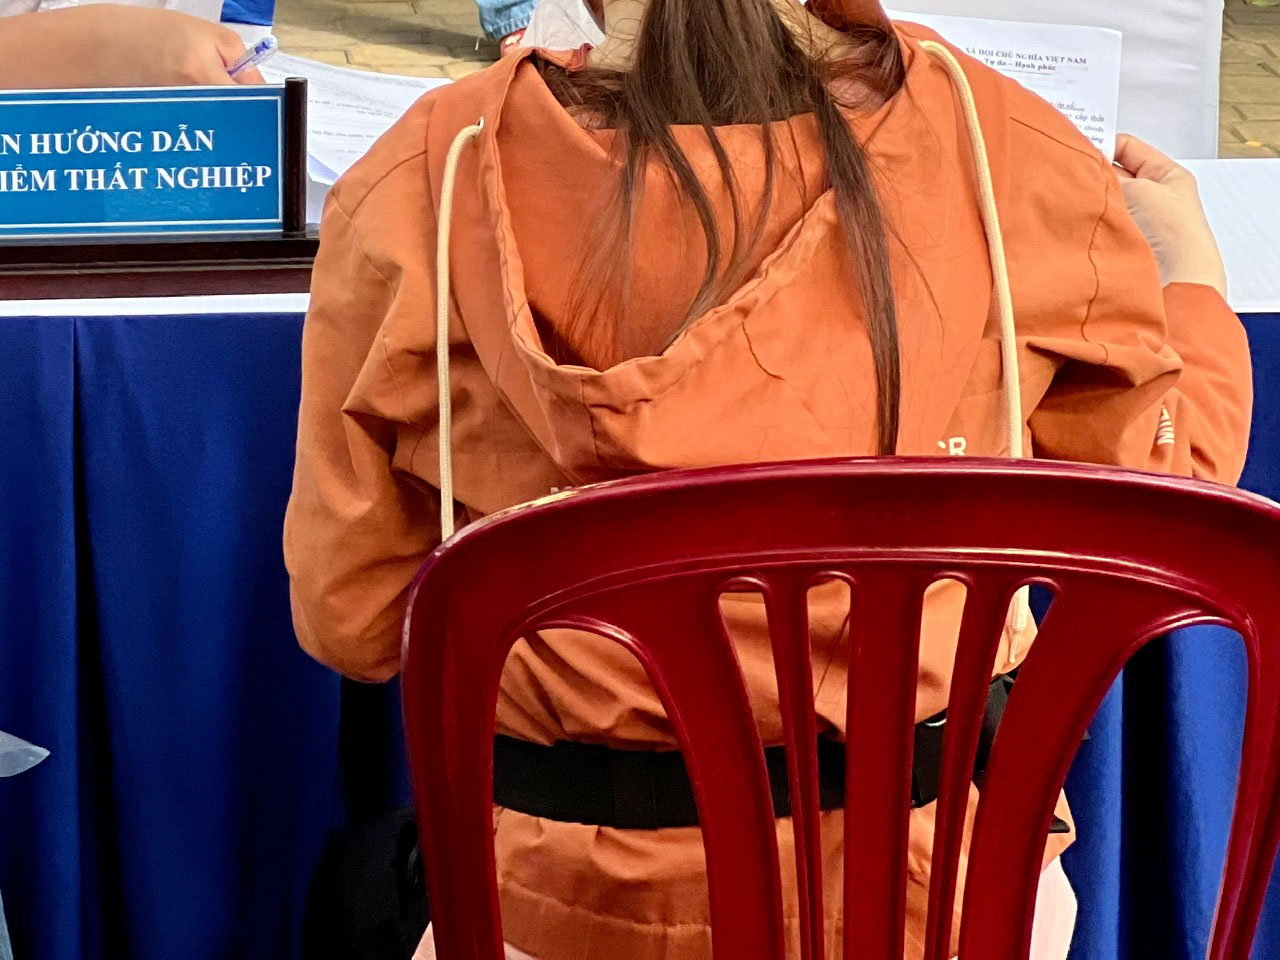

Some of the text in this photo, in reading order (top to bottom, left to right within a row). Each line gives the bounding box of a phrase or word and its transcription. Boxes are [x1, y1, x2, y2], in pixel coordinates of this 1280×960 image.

[29, 125, 143, 155] HƯỚNG
[152, 123, 215, 153] DẪN
[64, 161, 148, 192] THẤT
[157, 161, 272, 194] NGHIỆP
